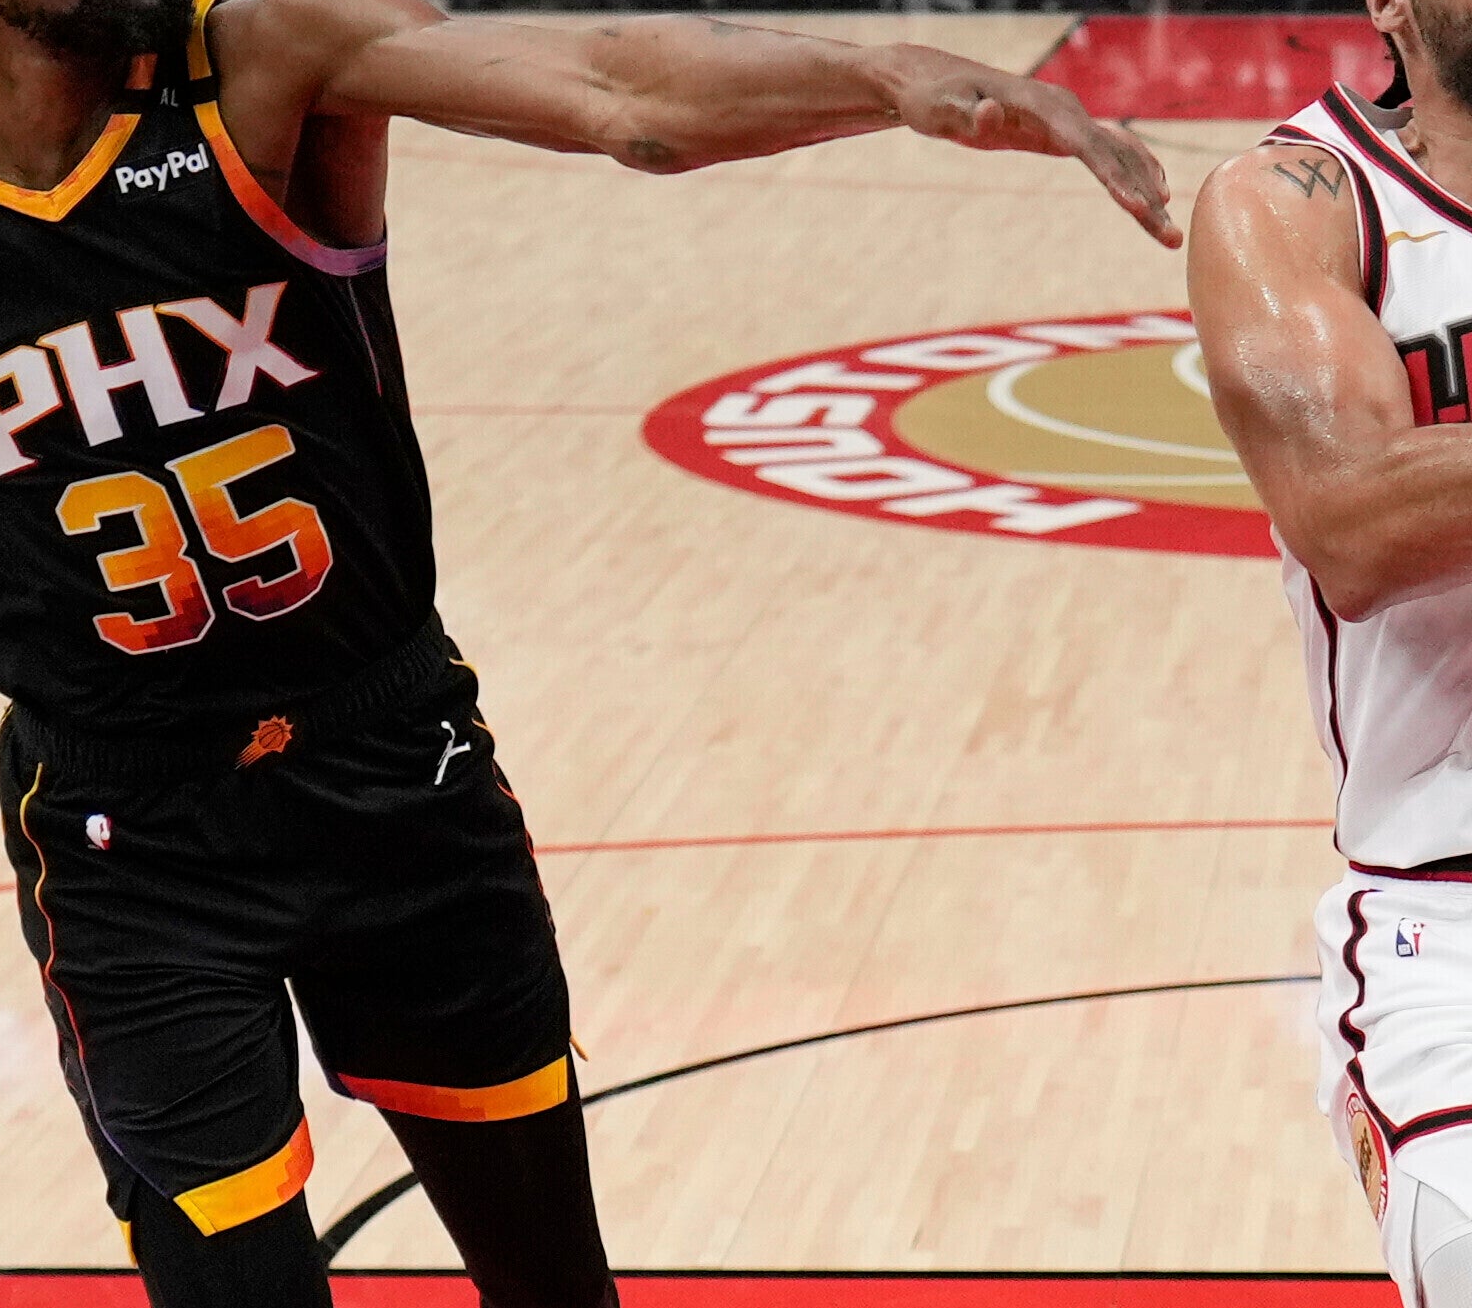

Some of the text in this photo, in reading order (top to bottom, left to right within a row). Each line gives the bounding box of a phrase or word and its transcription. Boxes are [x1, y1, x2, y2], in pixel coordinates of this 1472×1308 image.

[160, 87, 179, 107] AL
[115, 143, 210, 194] PayPal
[702, 315, 1198, 535] HOUSTON
[55, 424, 333, 655] 35
